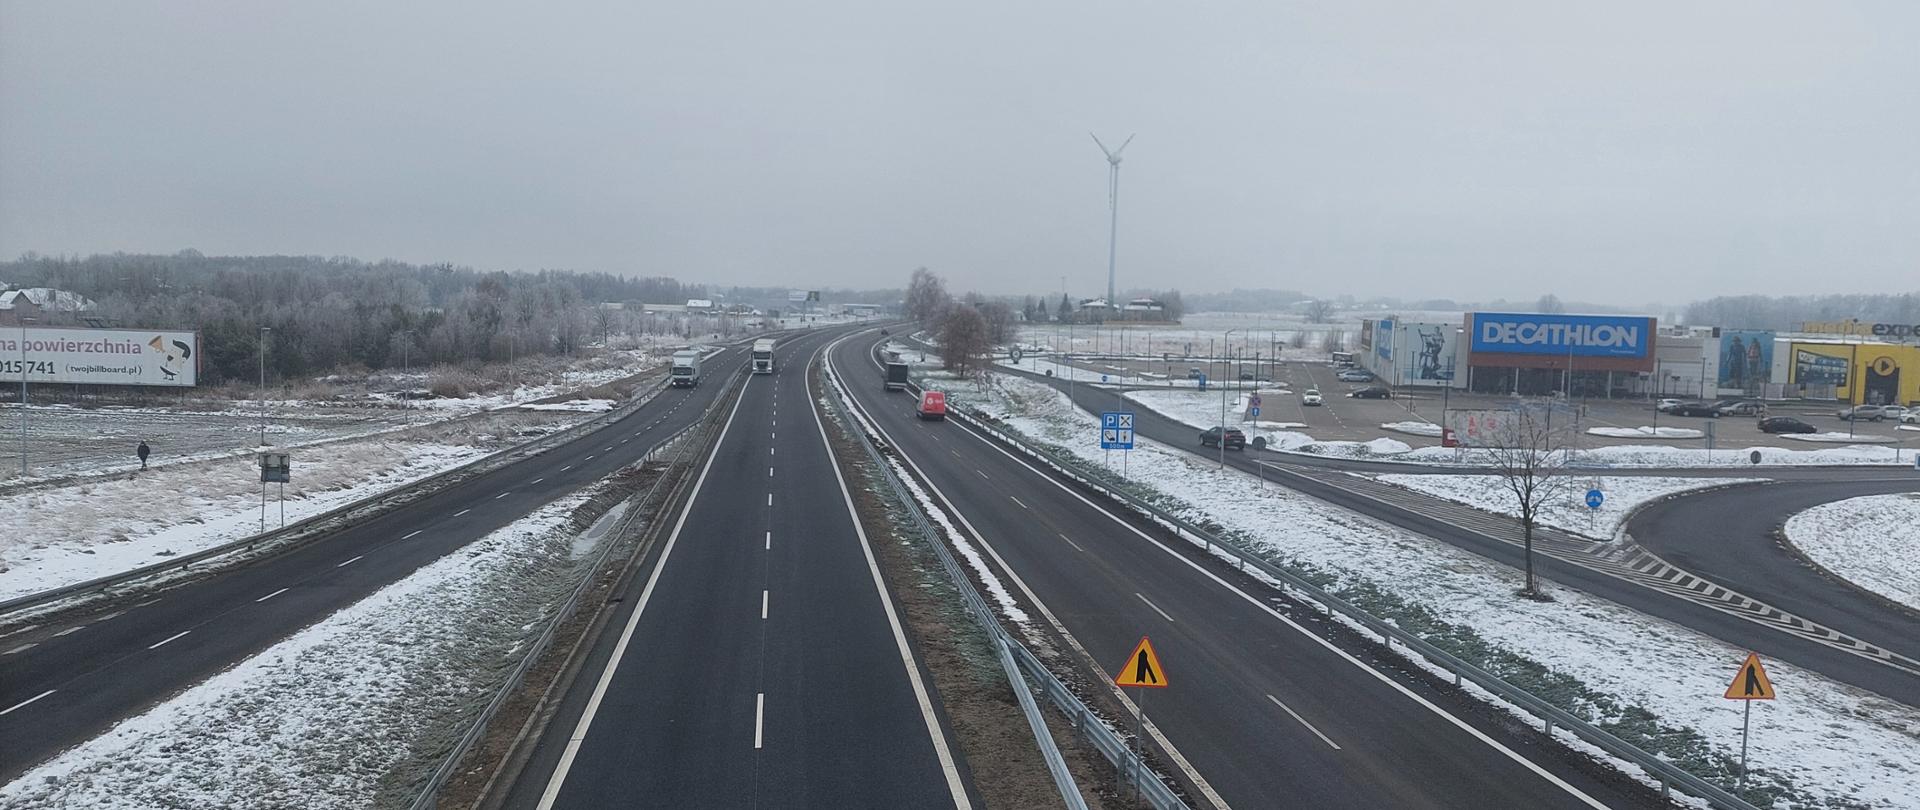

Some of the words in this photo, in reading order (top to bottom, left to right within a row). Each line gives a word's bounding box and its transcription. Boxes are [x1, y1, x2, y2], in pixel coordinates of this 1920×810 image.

[1482, 321, 1638, 347] DECATHLON
[22, 337, 142, 354] powierzchnia
[26, 361, 55, 374] 741
[1106, 415, 1115, 426] P
